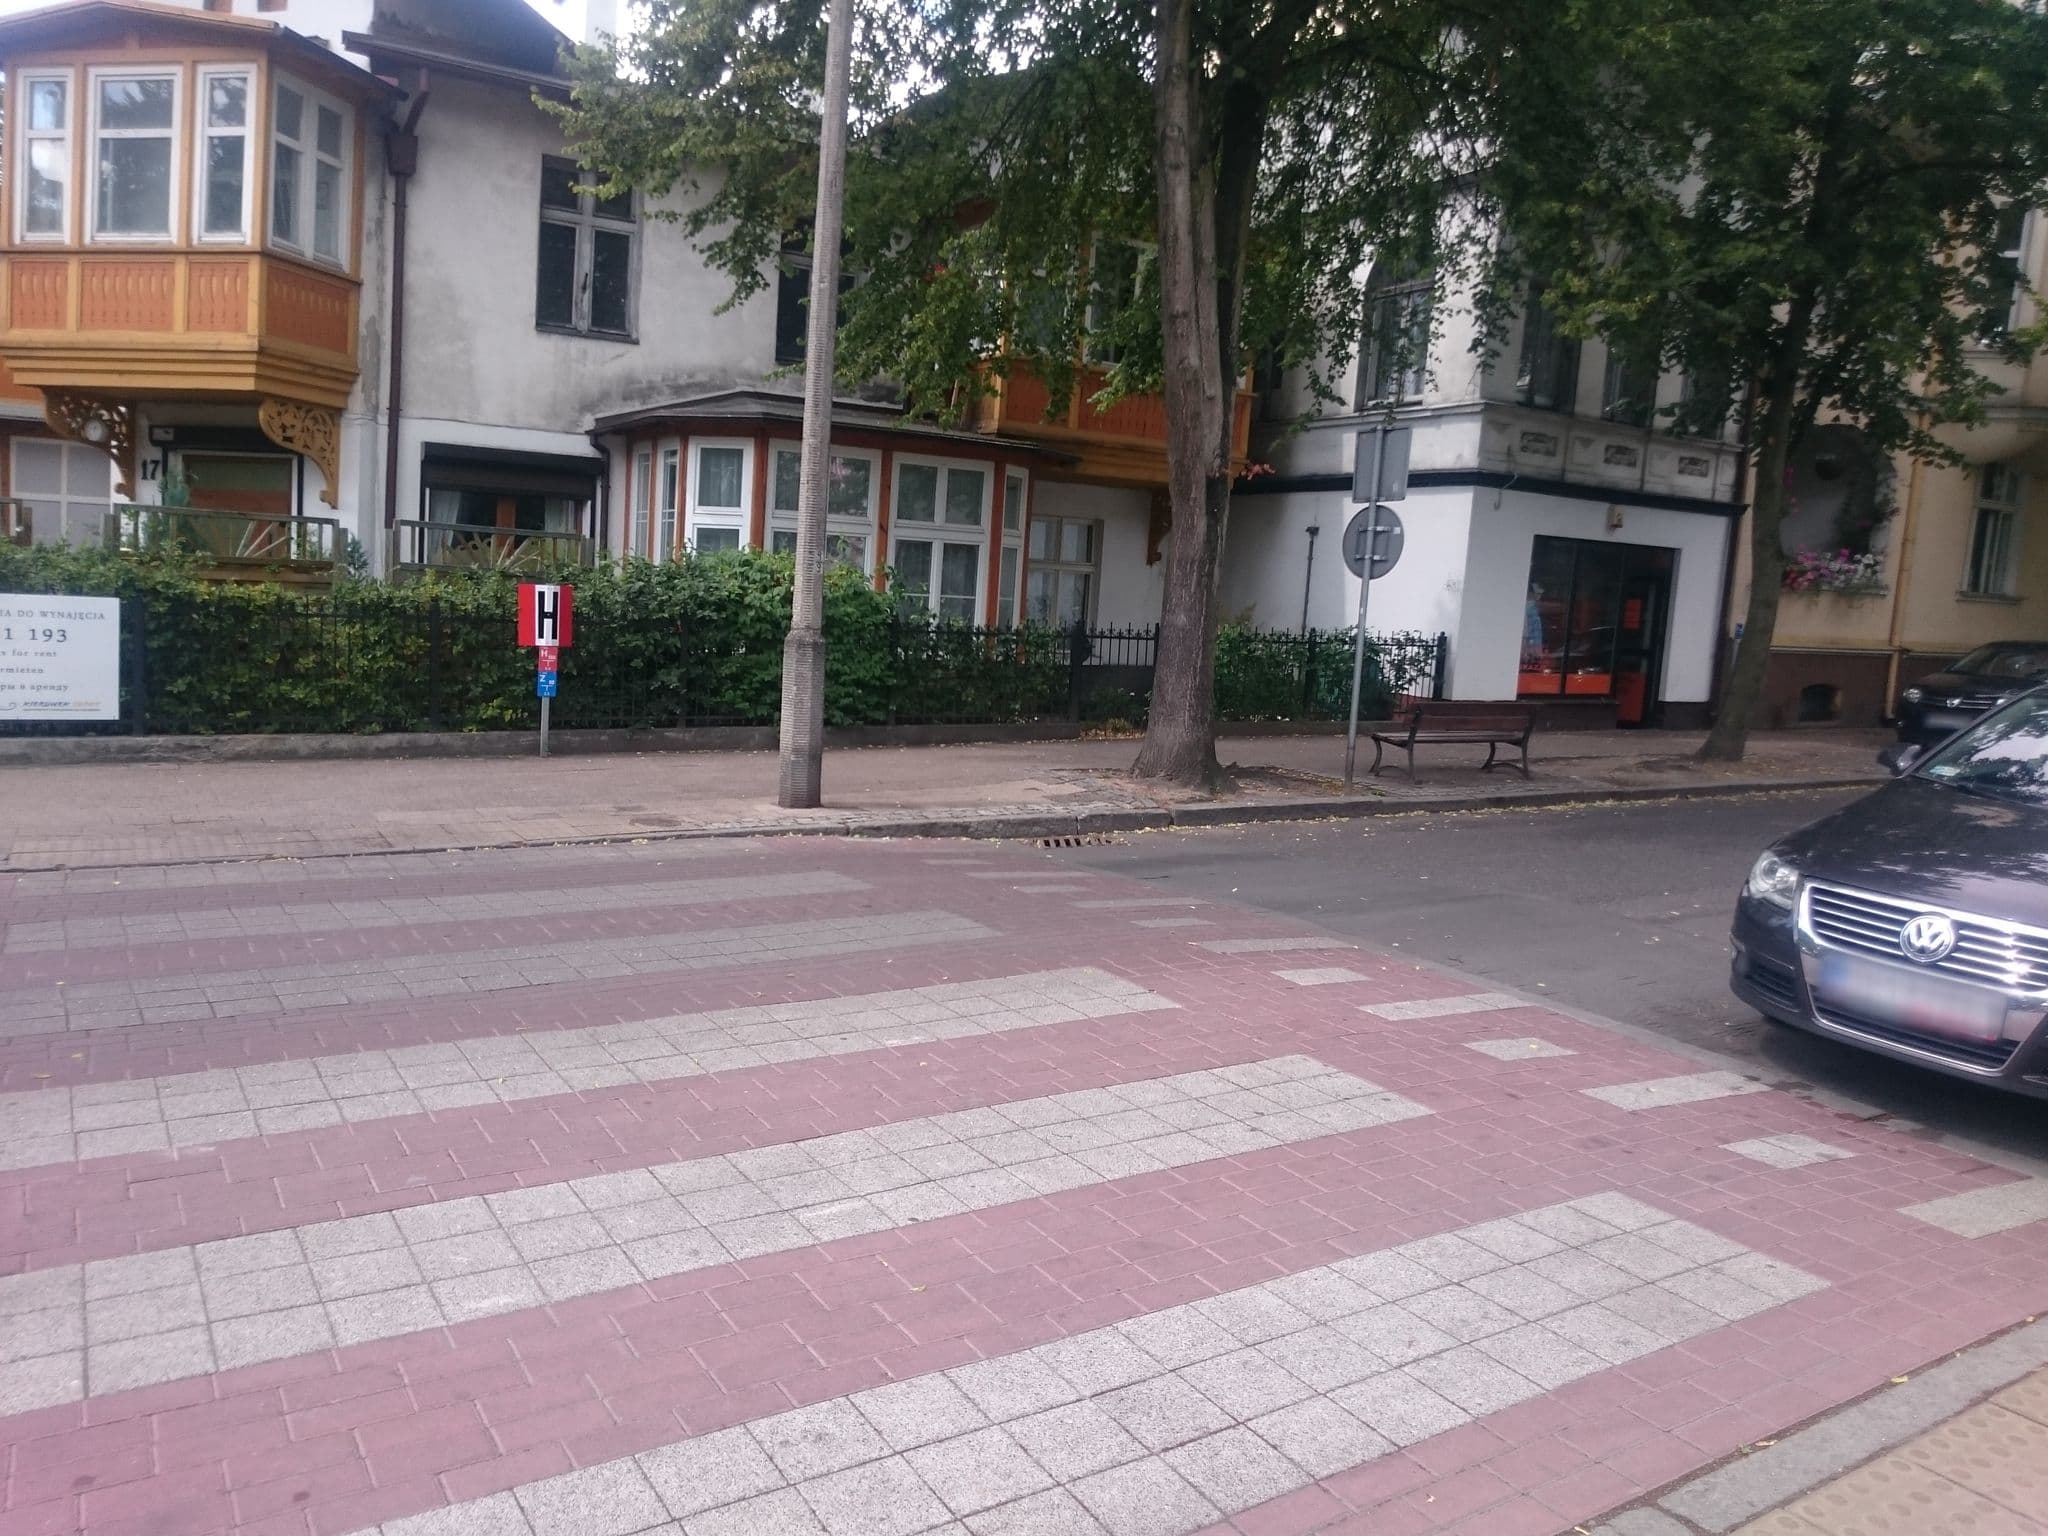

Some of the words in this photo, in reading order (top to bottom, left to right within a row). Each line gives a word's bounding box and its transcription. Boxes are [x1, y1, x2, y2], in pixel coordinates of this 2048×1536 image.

[141, 459, 161, 481] 17
[18, 609, 34, 618] DO
[538, 590, 559, 640] H
[28, 628, 68, 643] 193
[12, 648, 29, 657] for
[34, 650, 57, 658] rent
